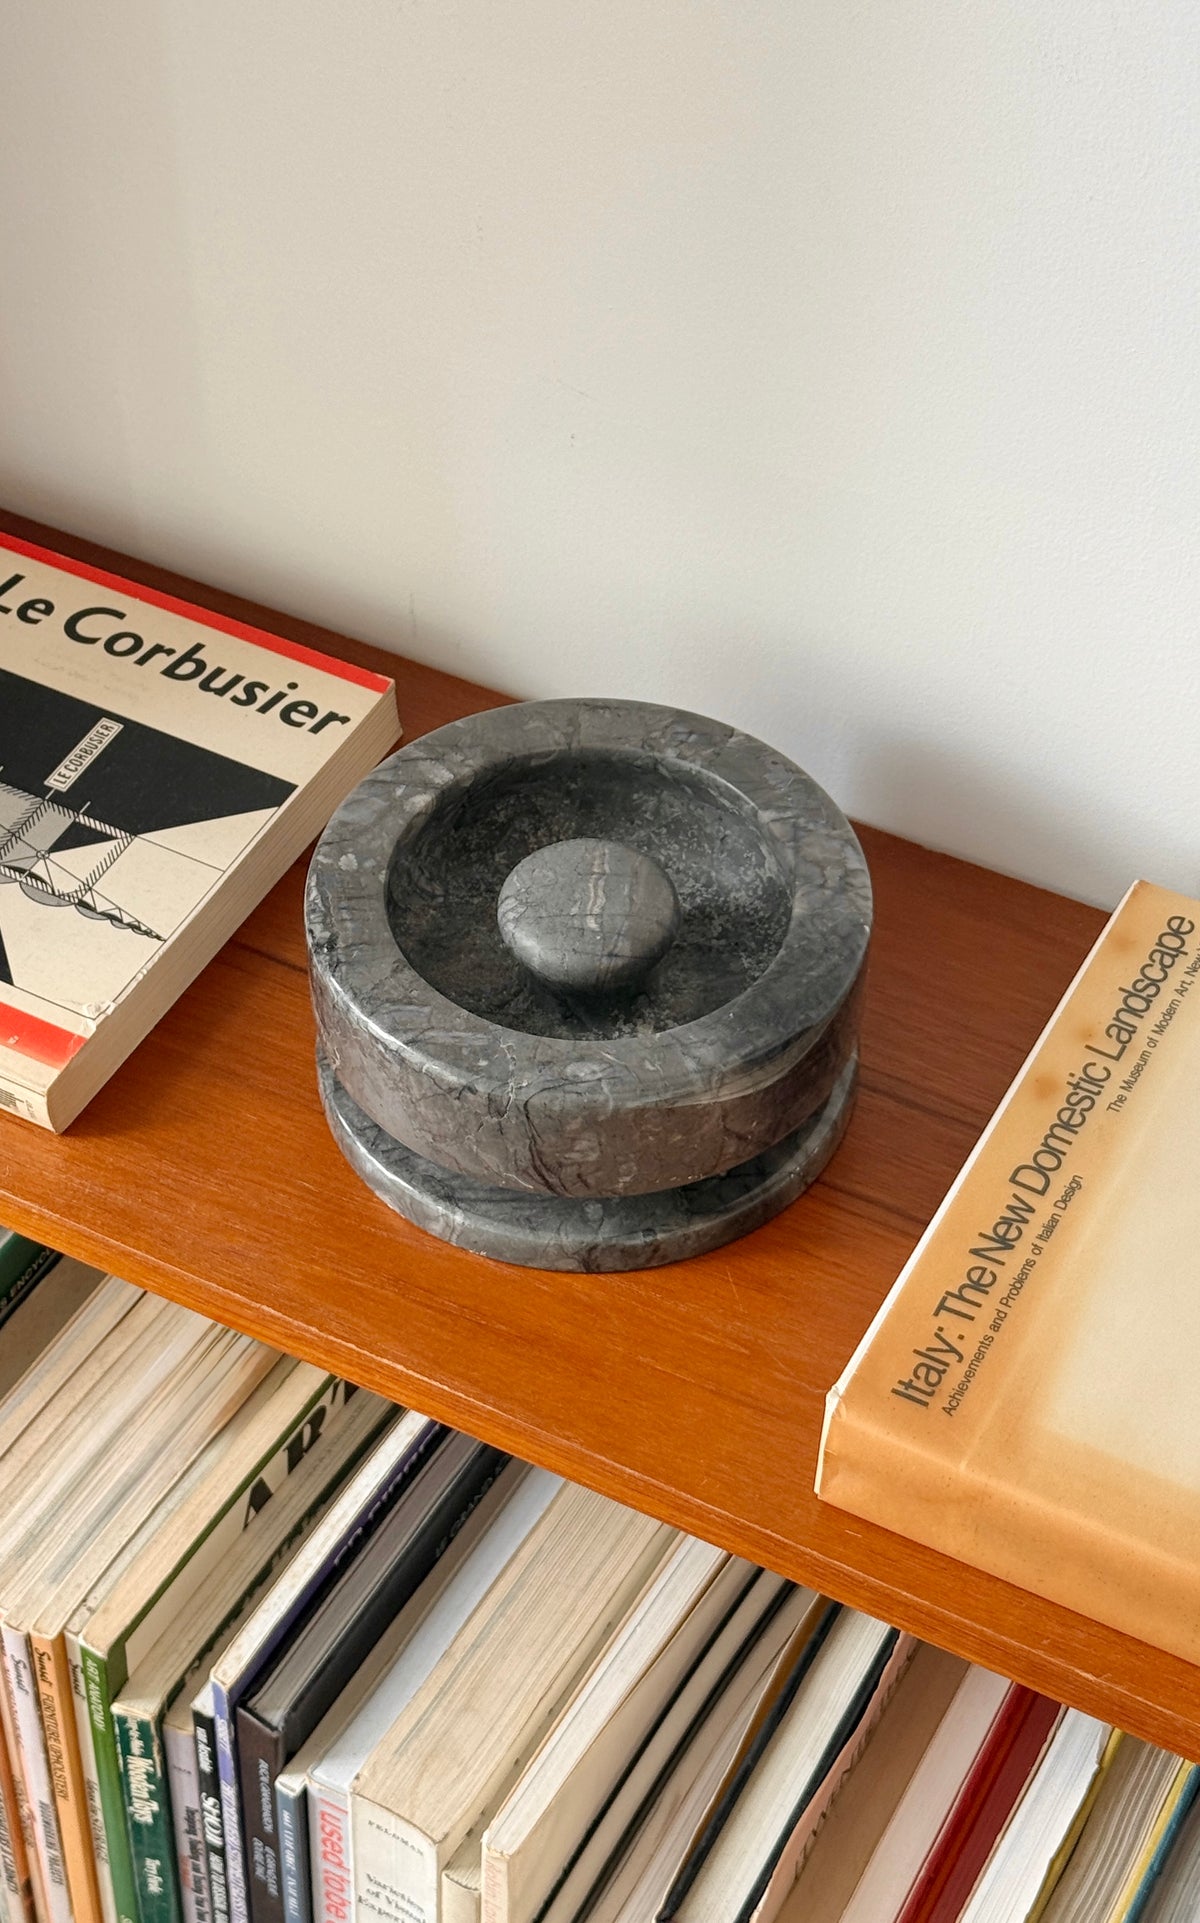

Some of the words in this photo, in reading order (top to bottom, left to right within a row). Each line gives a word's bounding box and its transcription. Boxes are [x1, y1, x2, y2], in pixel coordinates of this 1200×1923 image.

[0, 573, 55, 625] Le
[63, 606, 352, 736] Corbusier
[53, 771, 72, 785] LE
[64, 723, 115, 773] CORBUSIER
[1174, 980, 1195, 997] Art,
[1151, 998, 1182, 1036] Modern
[1146, 1035, 1160, 1049] of
[1119, 1050, 1153, 1093] Museum
[1106, 1093, 1128, 1113] The
[891, 1325, 965, 1408] Italy:
[932, 1265, 997, 1322] The
[968, 1192, 1037, 1267] New
[1008, 1061, 1112, 1197] Domestic
[1084, 915, 1195, 1062] Landscape
[1053, 1173, 1084, 1212] Design
[1036, 1211, 1063, 1244] Italian
[1031, 1242, 1046, 1257] of
[999, 1257, 1036, 1309] Problems
[989, 1308, 1008, 1333] and
[941, 1333, 995, 1418] Achievements
[35, 1646, 53, 1690] Sunset
[84, 1656, 99, 1685] ART
[42, 1691, 62, 1749] FURNITURE
[87, 1680, 106, 1732] ANATOMY
[50, 1742, 70, 1803] UPHOLSTERY
[126, 1754, 156, 1803] Wooden
[128, 1797, 160, 1826] Toys
[200, 1792, 224, 1848] SHOJI
[319, 1809, 350, 1873] used
[322, 1868, 350, 1894] to
[325, 1890, 351, 1921] be
